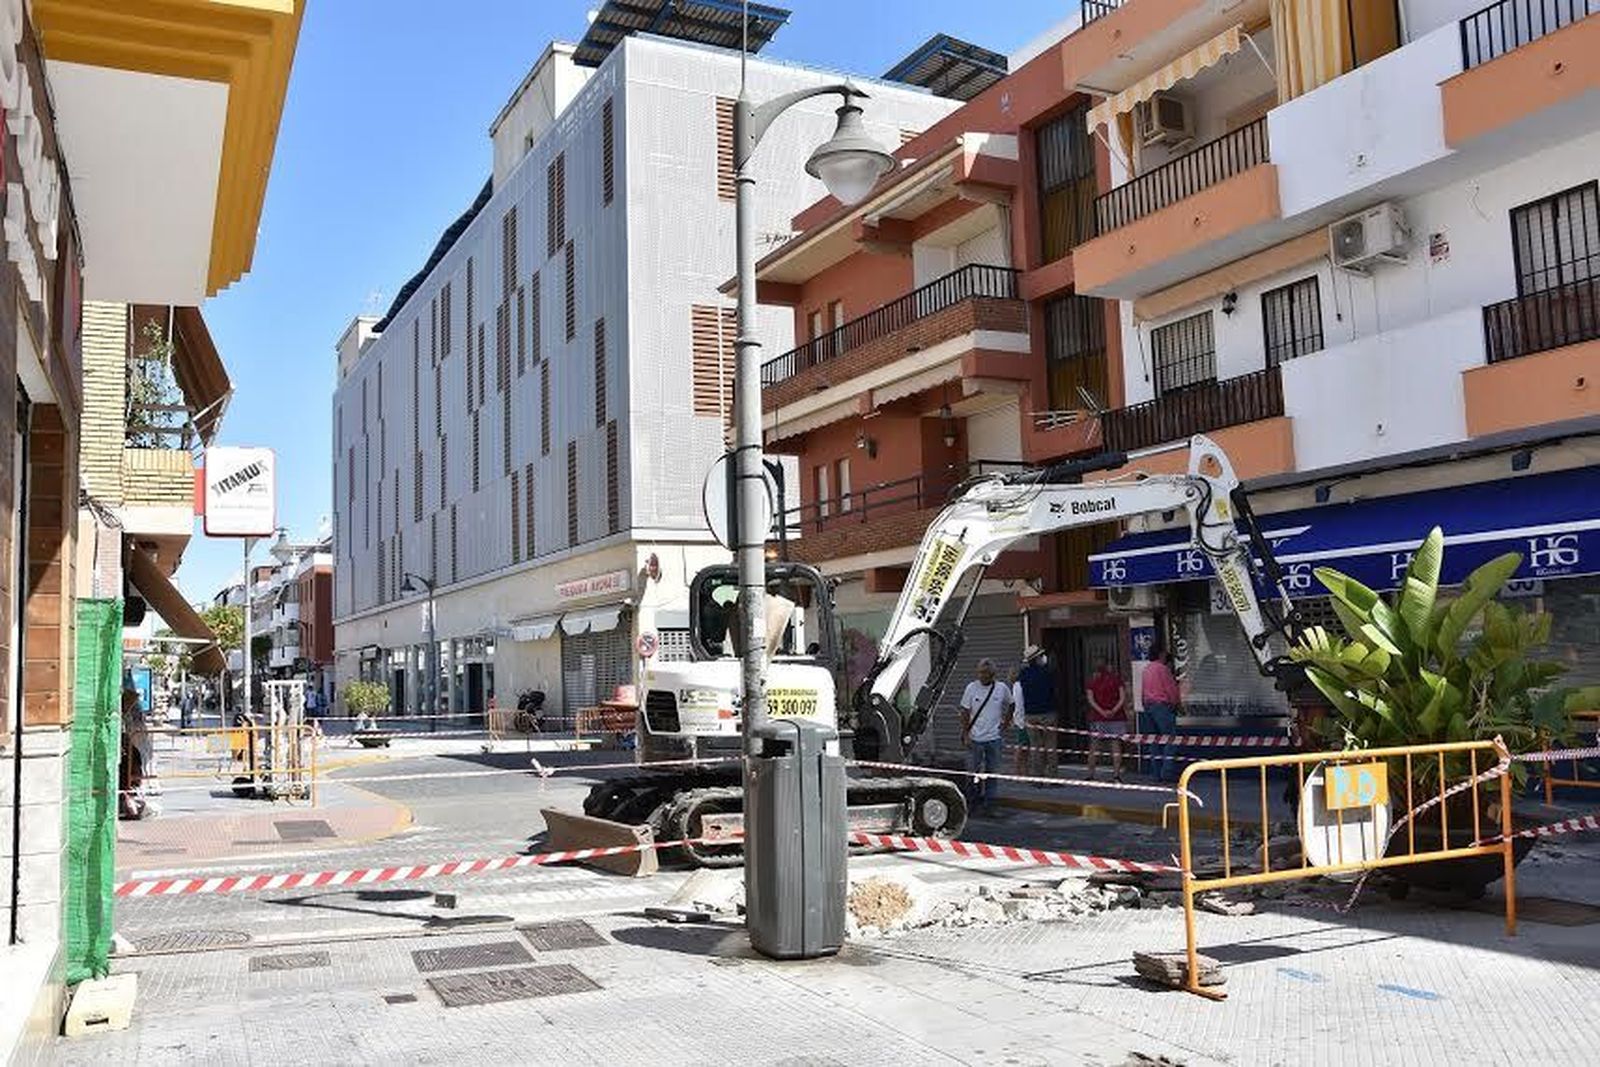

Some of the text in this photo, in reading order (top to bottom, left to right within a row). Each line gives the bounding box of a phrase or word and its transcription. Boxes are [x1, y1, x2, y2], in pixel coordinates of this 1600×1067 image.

[1071, 497, 1116, 515] Bobcat
[1177, 549, 1204, 573] HG
[1527, 535, 1578, 567] HG
[1102, 559, 1126, 580] HG
